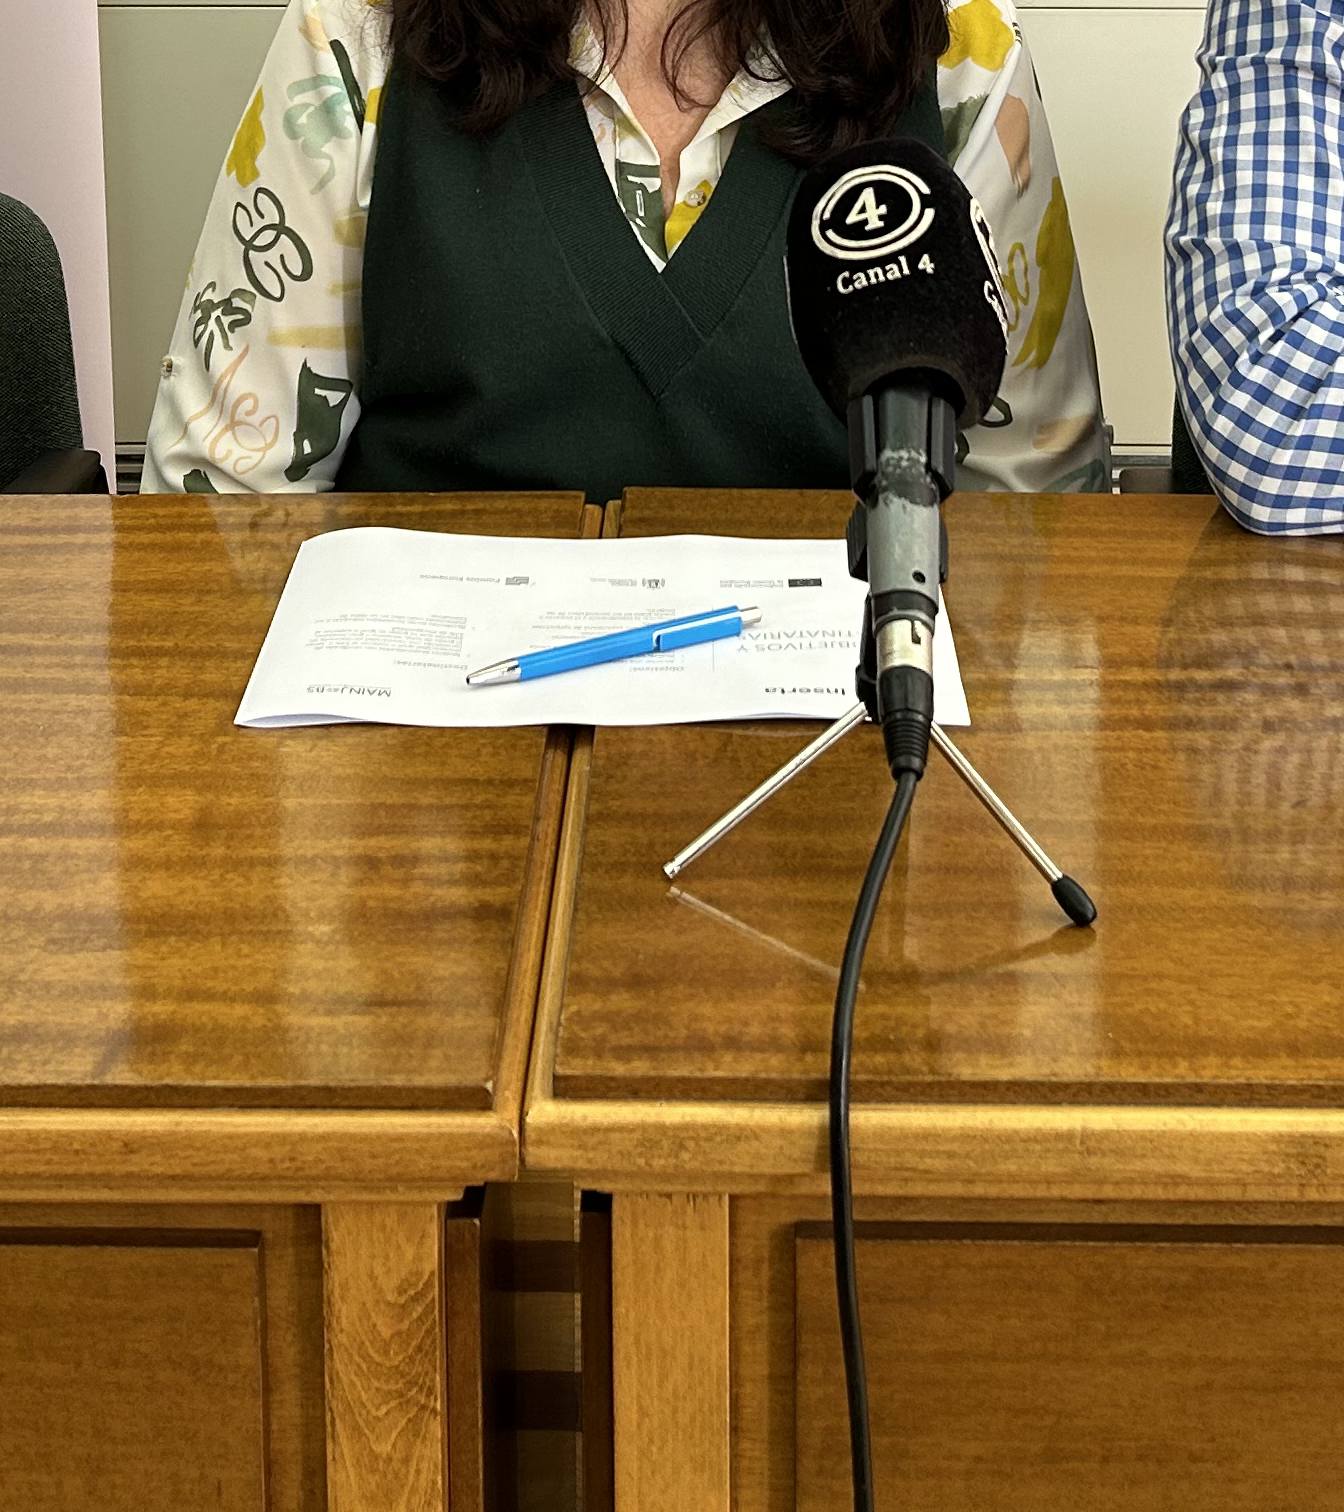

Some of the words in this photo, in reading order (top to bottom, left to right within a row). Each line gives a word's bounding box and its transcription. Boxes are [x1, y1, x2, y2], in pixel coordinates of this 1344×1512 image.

[845, 186, 888, 232] 4
[836, 255, 912, 295] Canal
[917, 253, 936, 275] 4
